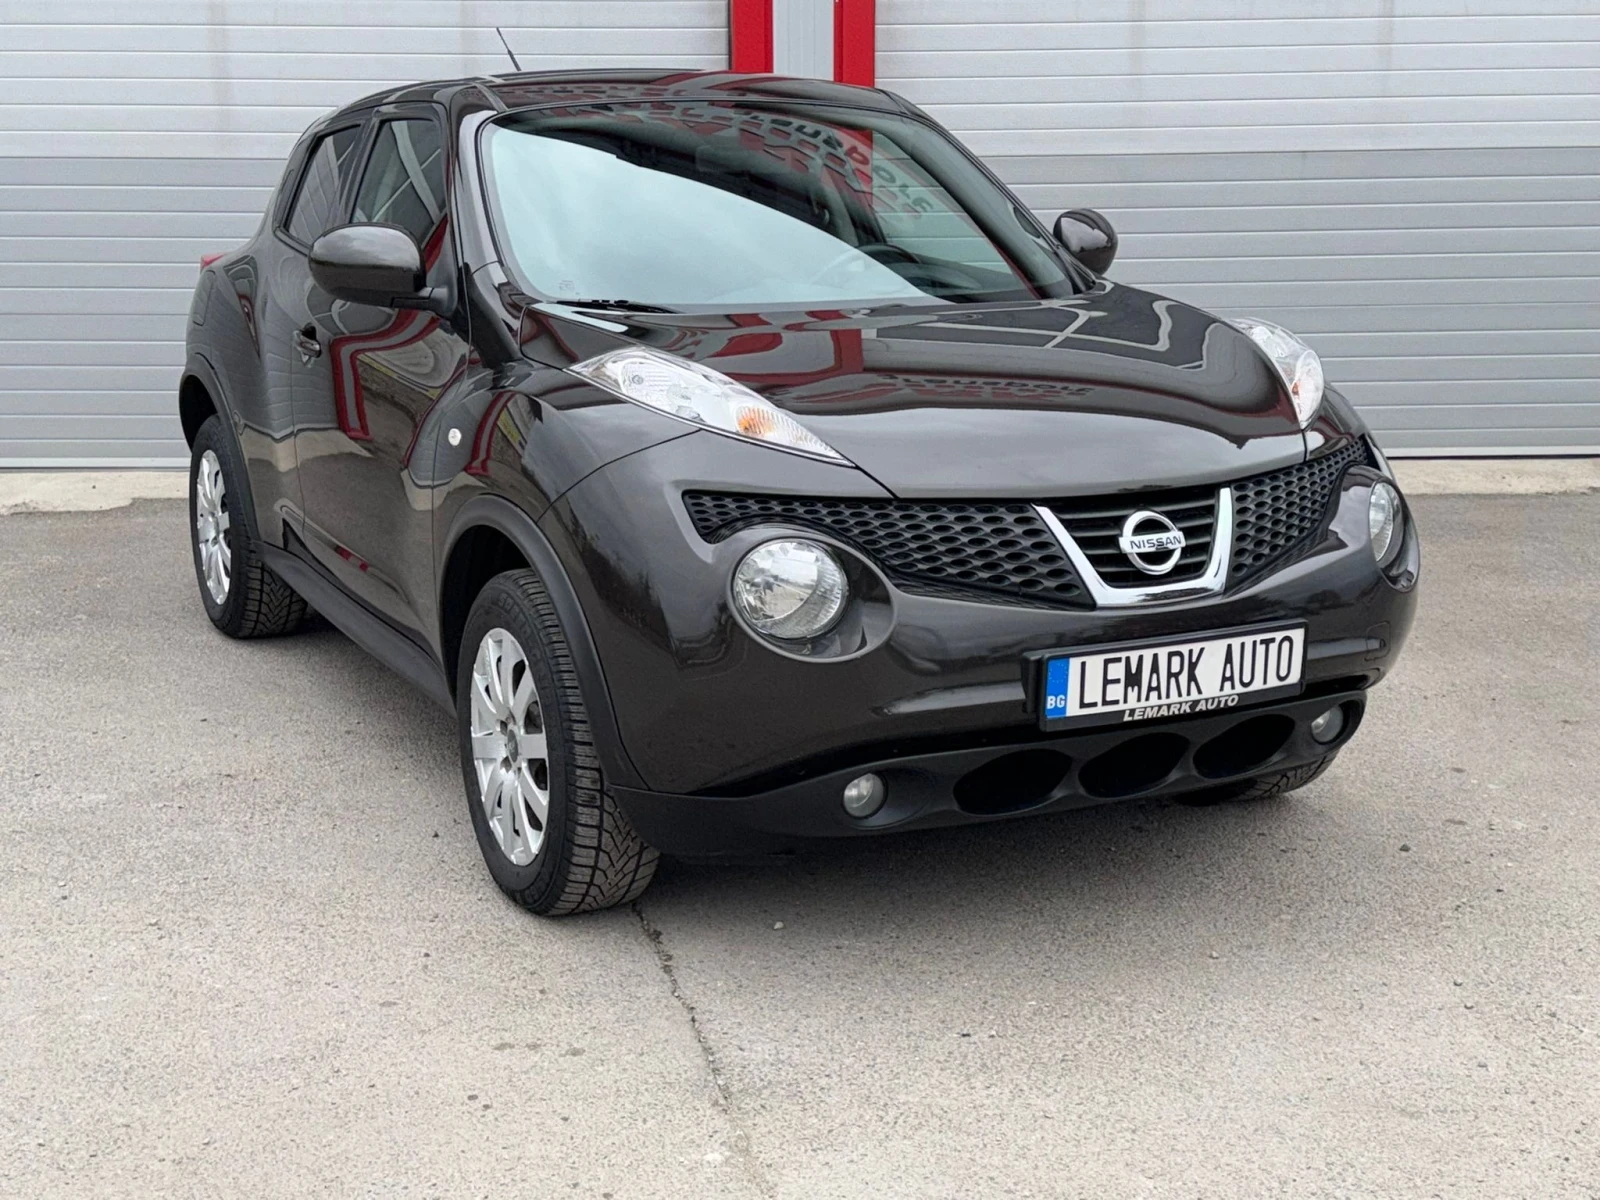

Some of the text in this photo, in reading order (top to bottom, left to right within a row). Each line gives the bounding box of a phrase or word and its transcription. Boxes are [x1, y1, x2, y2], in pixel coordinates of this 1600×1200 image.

[1129, 535, 1181, 550] NISSAN
[1078, 635, 1294, 709] LEMARK AUTO
[1046, 695, 1065, 709] BG
[1123, 694, 1239, 722] LEMARK AUTO
